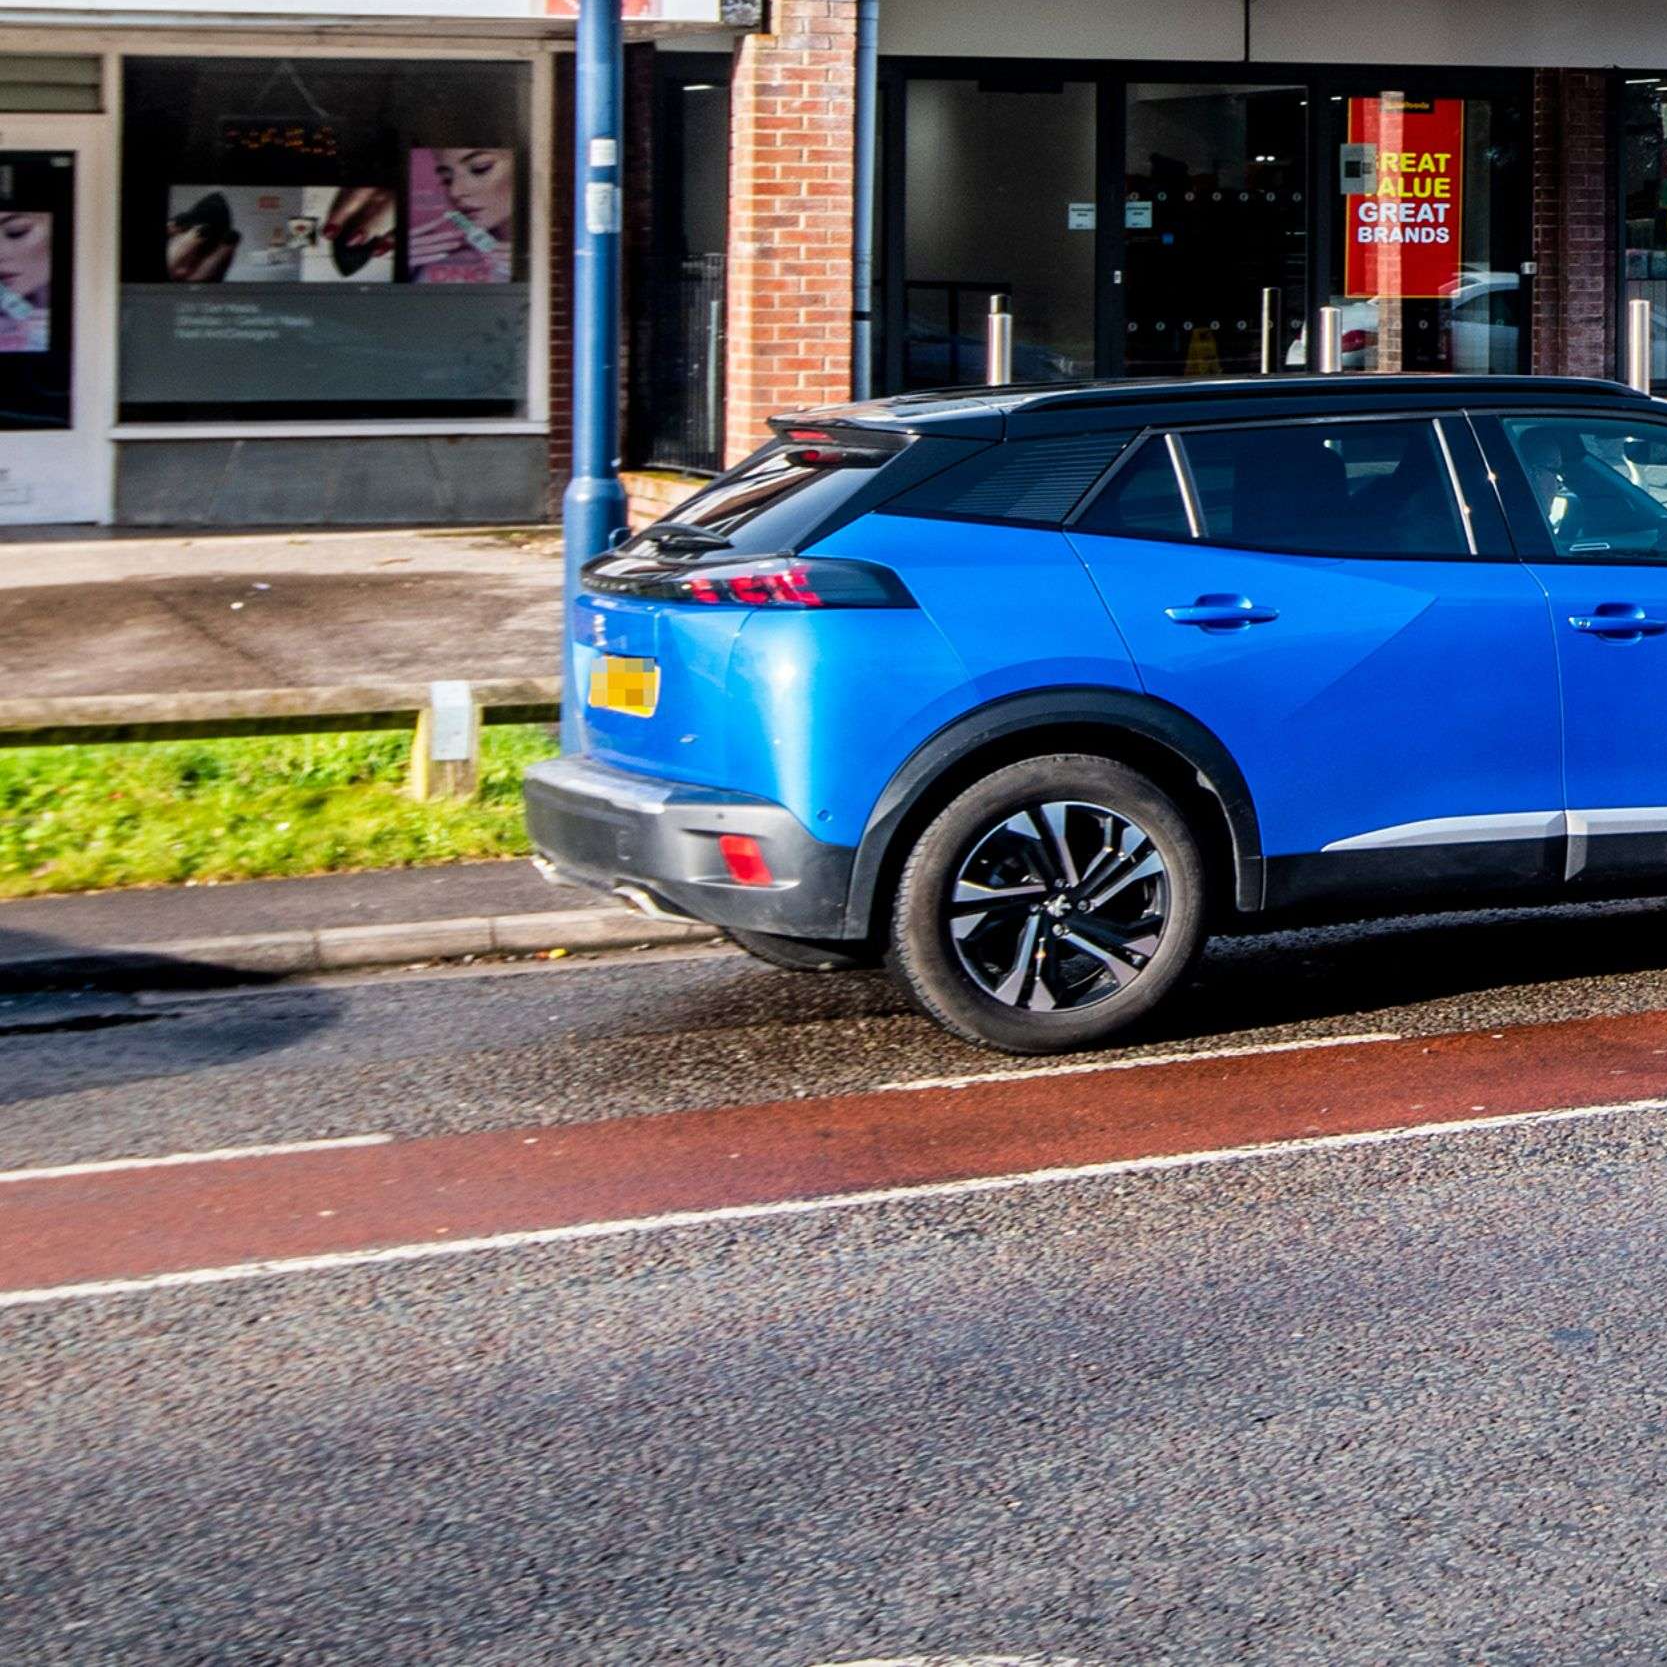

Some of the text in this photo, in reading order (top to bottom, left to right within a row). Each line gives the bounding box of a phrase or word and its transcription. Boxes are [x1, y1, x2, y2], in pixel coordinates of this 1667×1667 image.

[1376, 152, 1451, 173] REAT
[1365, 177, 1451, 198] ALUE
[1358, 201, 1451, 223] GREAT
[1357, 227, 1449, 243] BRANDS
